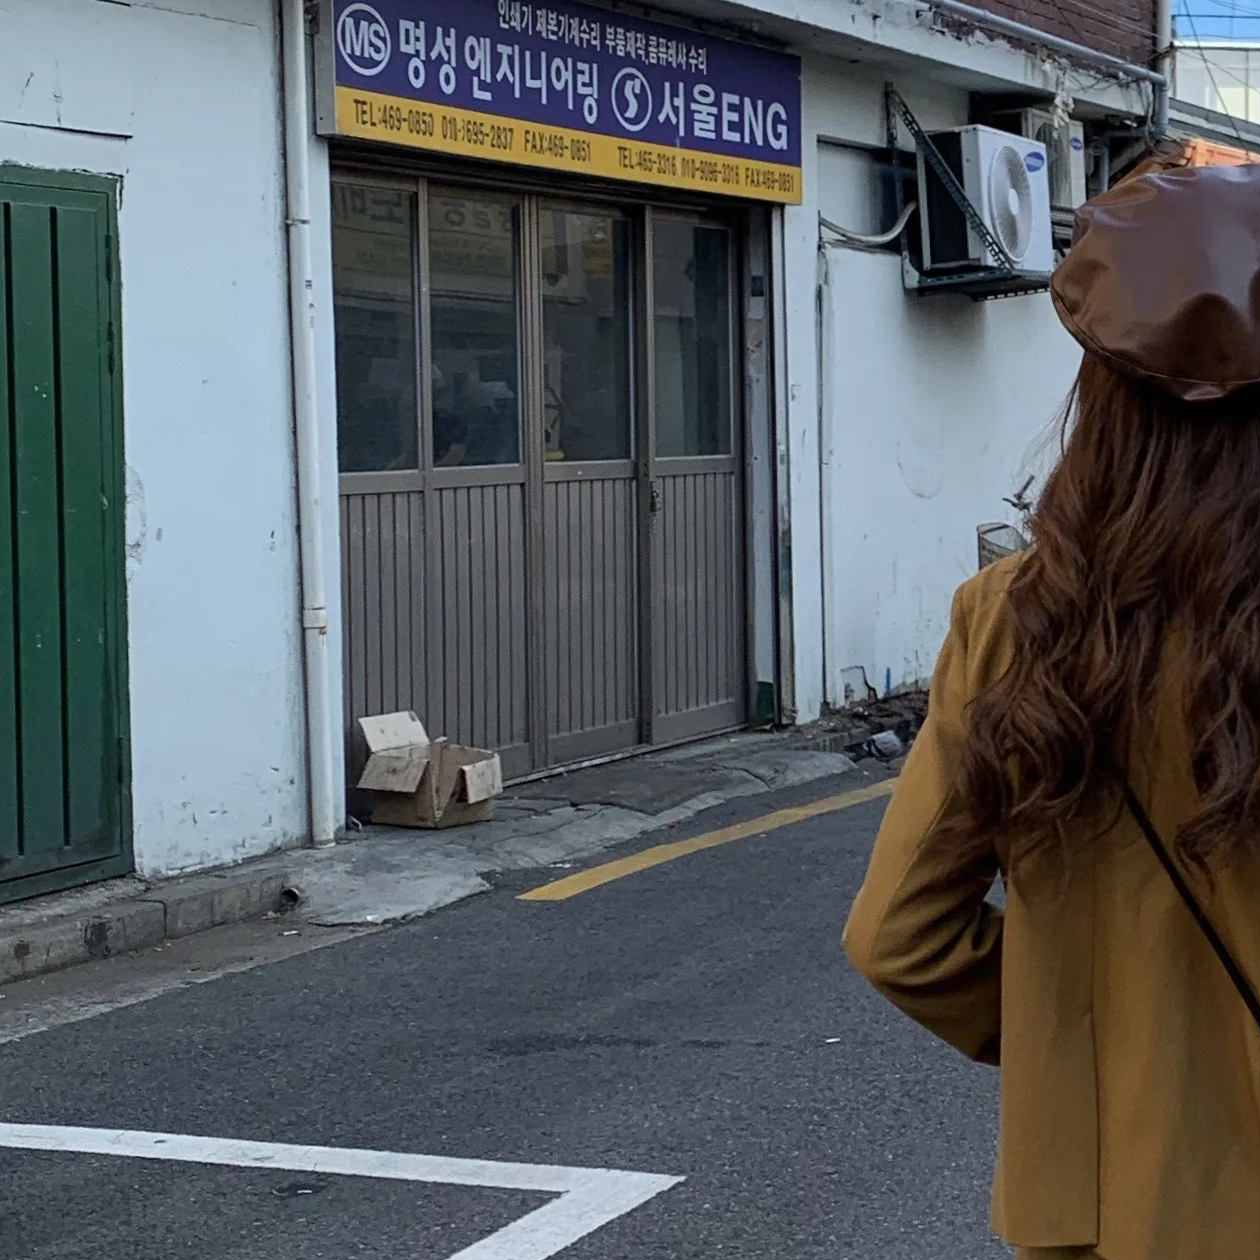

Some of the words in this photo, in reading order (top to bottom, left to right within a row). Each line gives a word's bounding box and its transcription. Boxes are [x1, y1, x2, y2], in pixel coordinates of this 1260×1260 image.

[344, 16, 386, 62] MS
[399, 18, 598, 124] 명성엔지니어링
[353, 98, 434, 138] TEL:469-0850
[657, 81, 788, 150] 서울ENG
